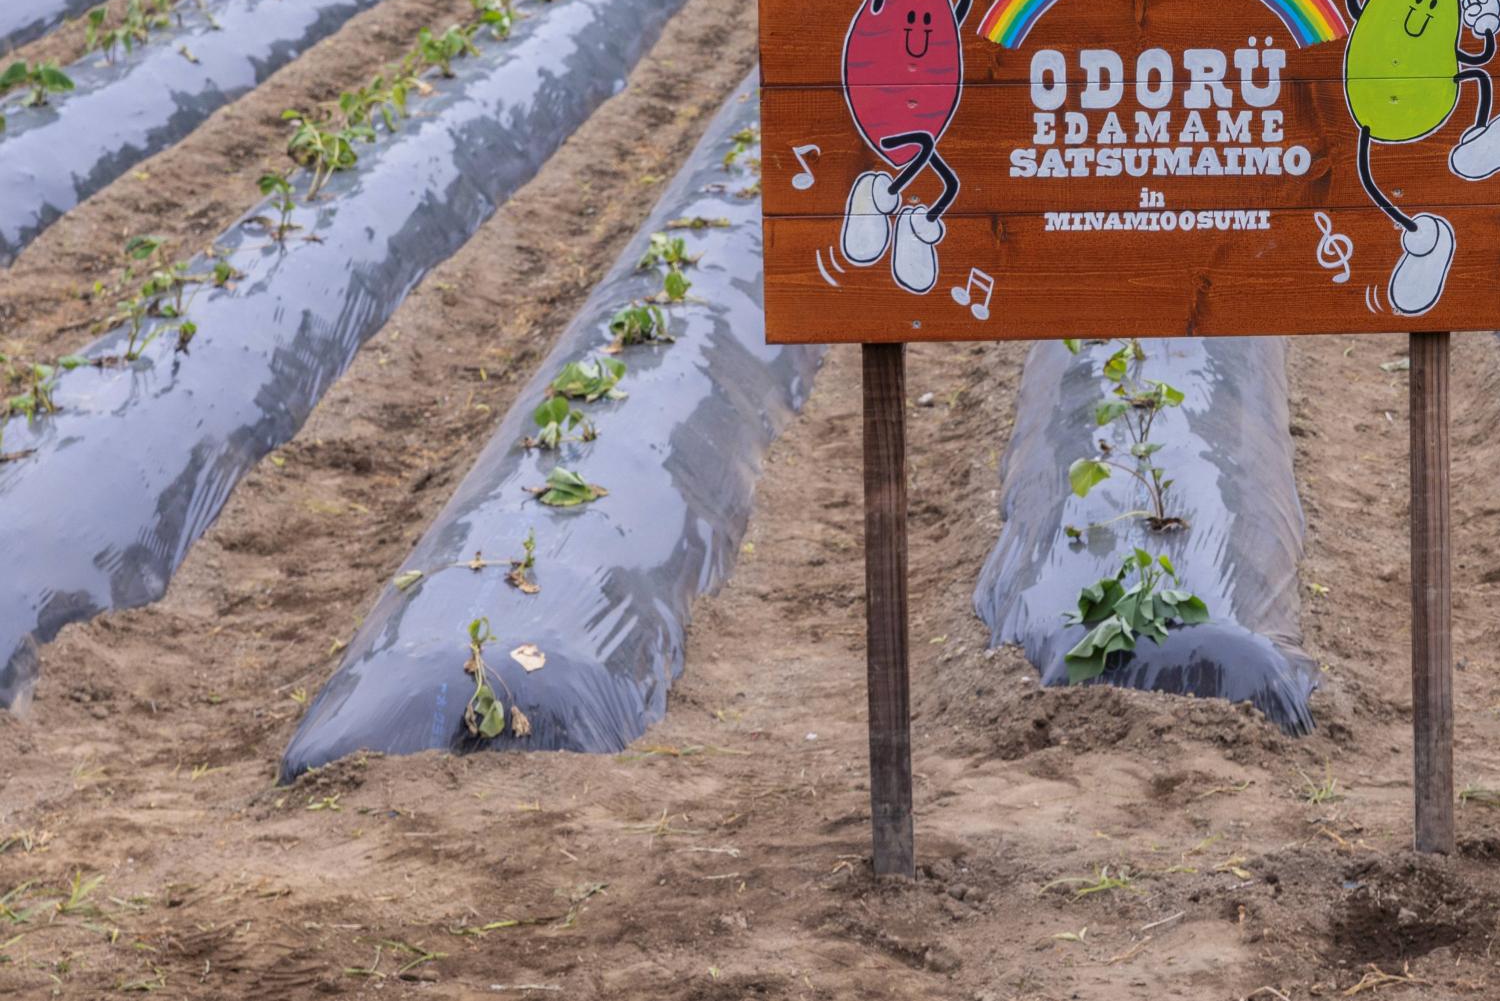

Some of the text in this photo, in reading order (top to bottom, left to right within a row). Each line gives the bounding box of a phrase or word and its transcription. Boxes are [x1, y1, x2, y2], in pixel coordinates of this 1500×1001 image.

[1029, 35, 1287, 111] ODORÜ
[1032, 109, 1284, 145] EDAMAME
[1009, 145, 1312, 178] SATSUMAIMO
[1139, 187, 1166, 208] in
[1043, 209, 1271, 232] MINAMIOOSUMI
